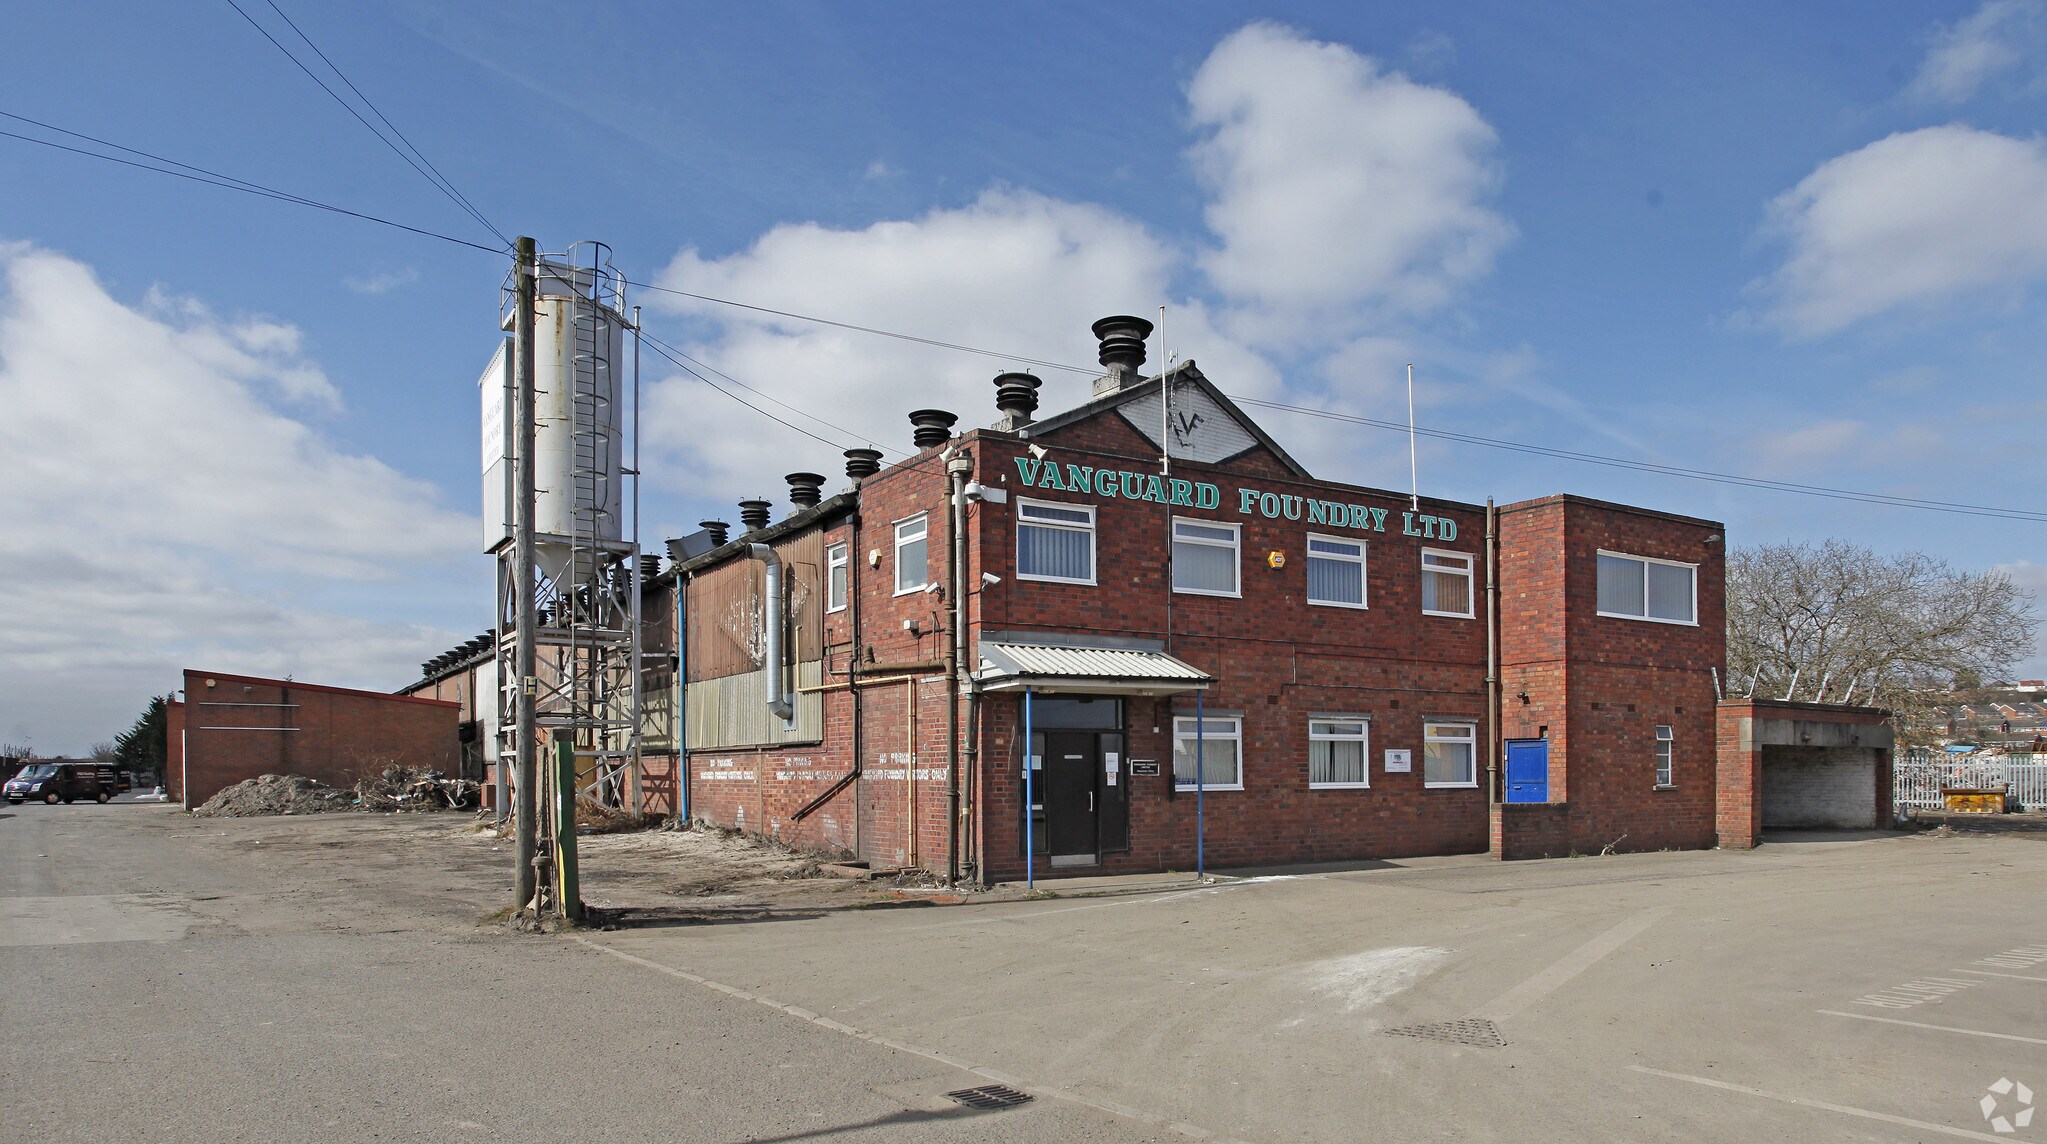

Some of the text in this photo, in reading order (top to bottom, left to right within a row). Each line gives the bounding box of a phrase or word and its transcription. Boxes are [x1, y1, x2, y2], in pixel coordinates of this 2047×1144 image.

[1014, 456, 1458, 542] VANGUARD FOUNDRY LTD
